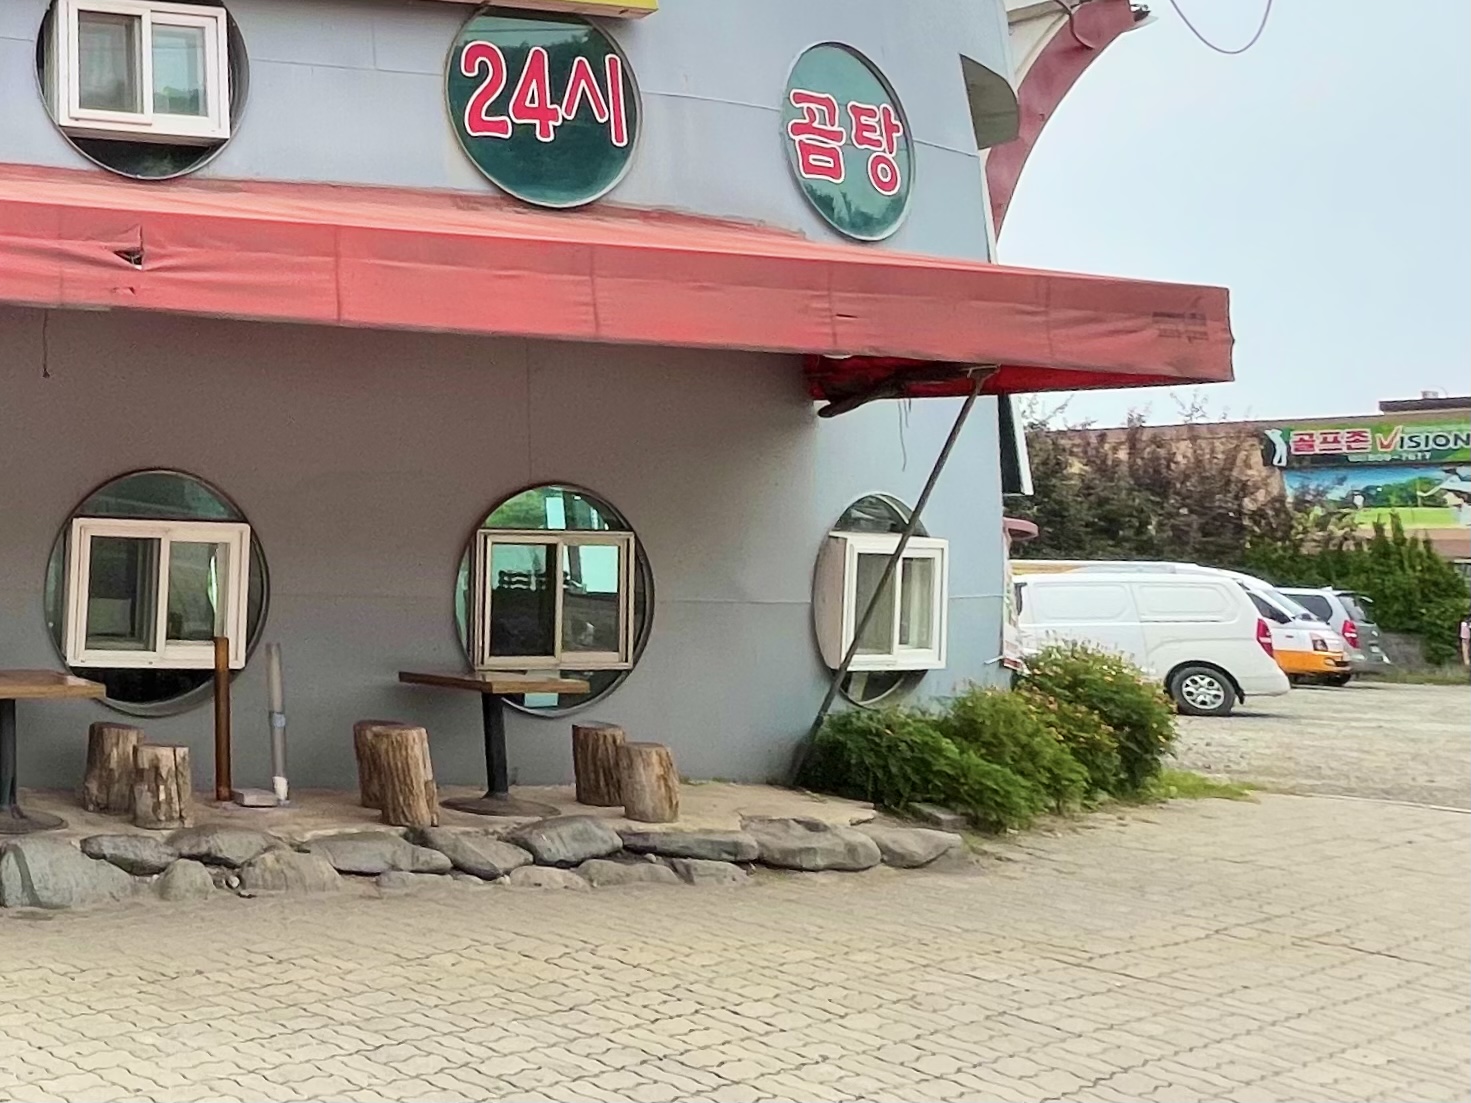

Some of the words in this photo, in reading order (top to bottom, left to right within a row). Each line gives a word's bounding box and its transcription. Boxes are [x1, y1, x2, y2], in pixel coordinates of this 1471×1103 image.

[460, 40, 628, 148] 24시
[787, 88, 903, 196] 곰탕
[1290, 428, 1372, 455] 골프존
[1375, 425, 1471, 453] VISION
